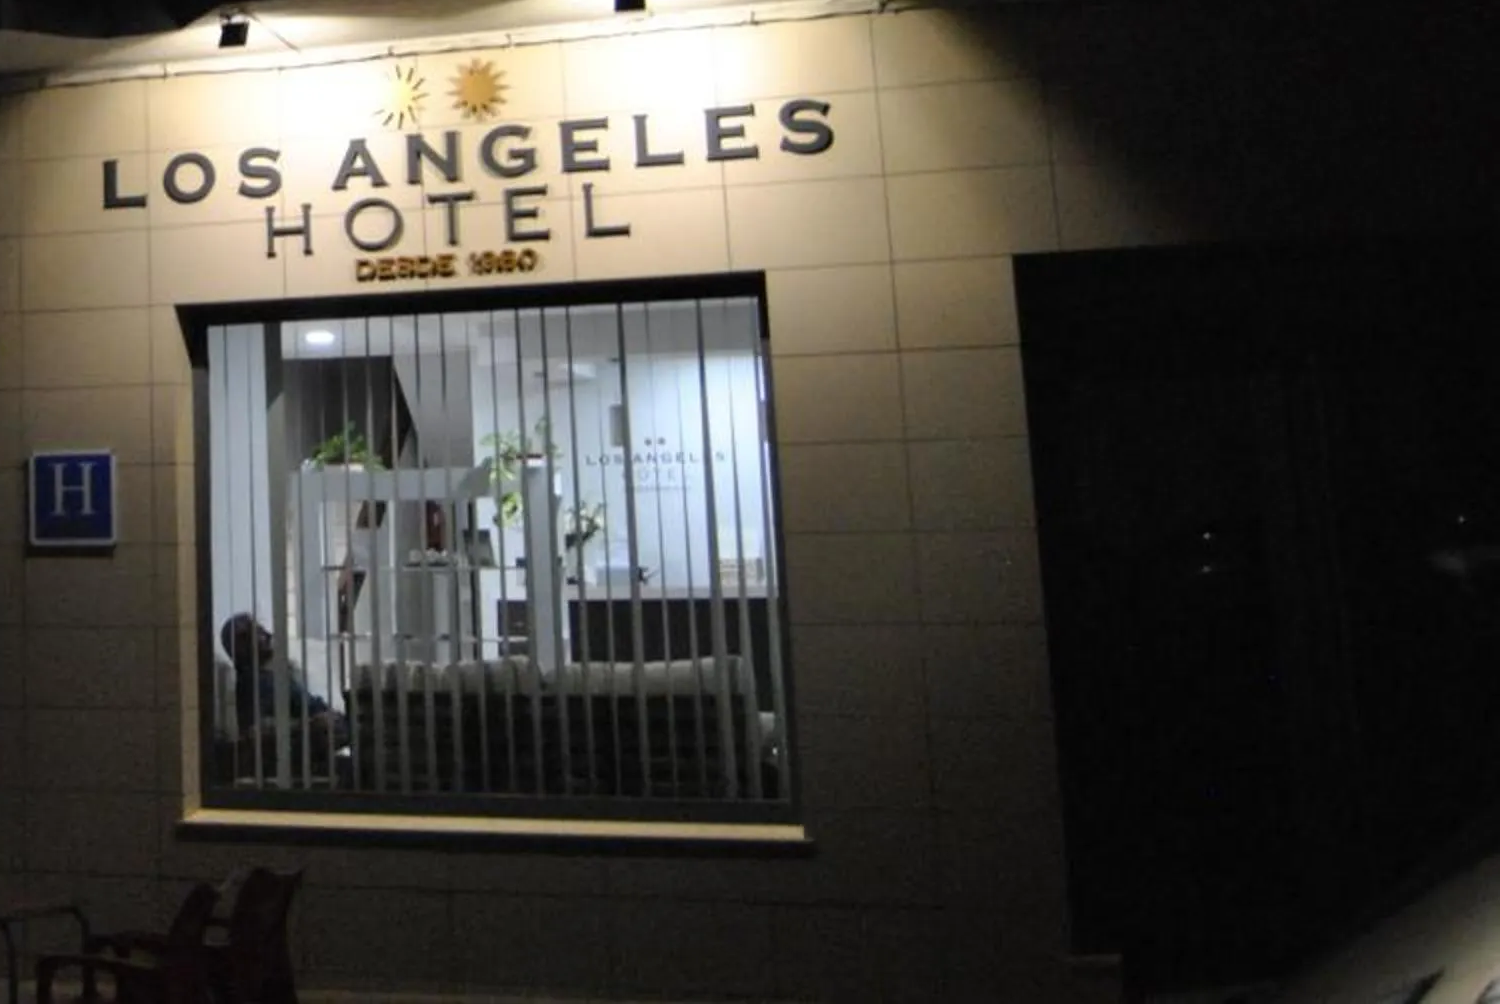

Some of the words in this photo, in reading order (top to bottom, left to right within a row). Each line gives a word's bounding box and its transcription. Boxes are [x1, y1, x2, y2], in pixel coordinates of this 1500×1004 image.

[102, 147, 283, 210] LOS
[331, 99, 835, 192] ANGELES
[265, 182, 631, 259] HOTEL
[355, 253, 456, 282] DESDE
[632, 450, 725, 466] ANGELS
[48, 460, 98, 518] H
